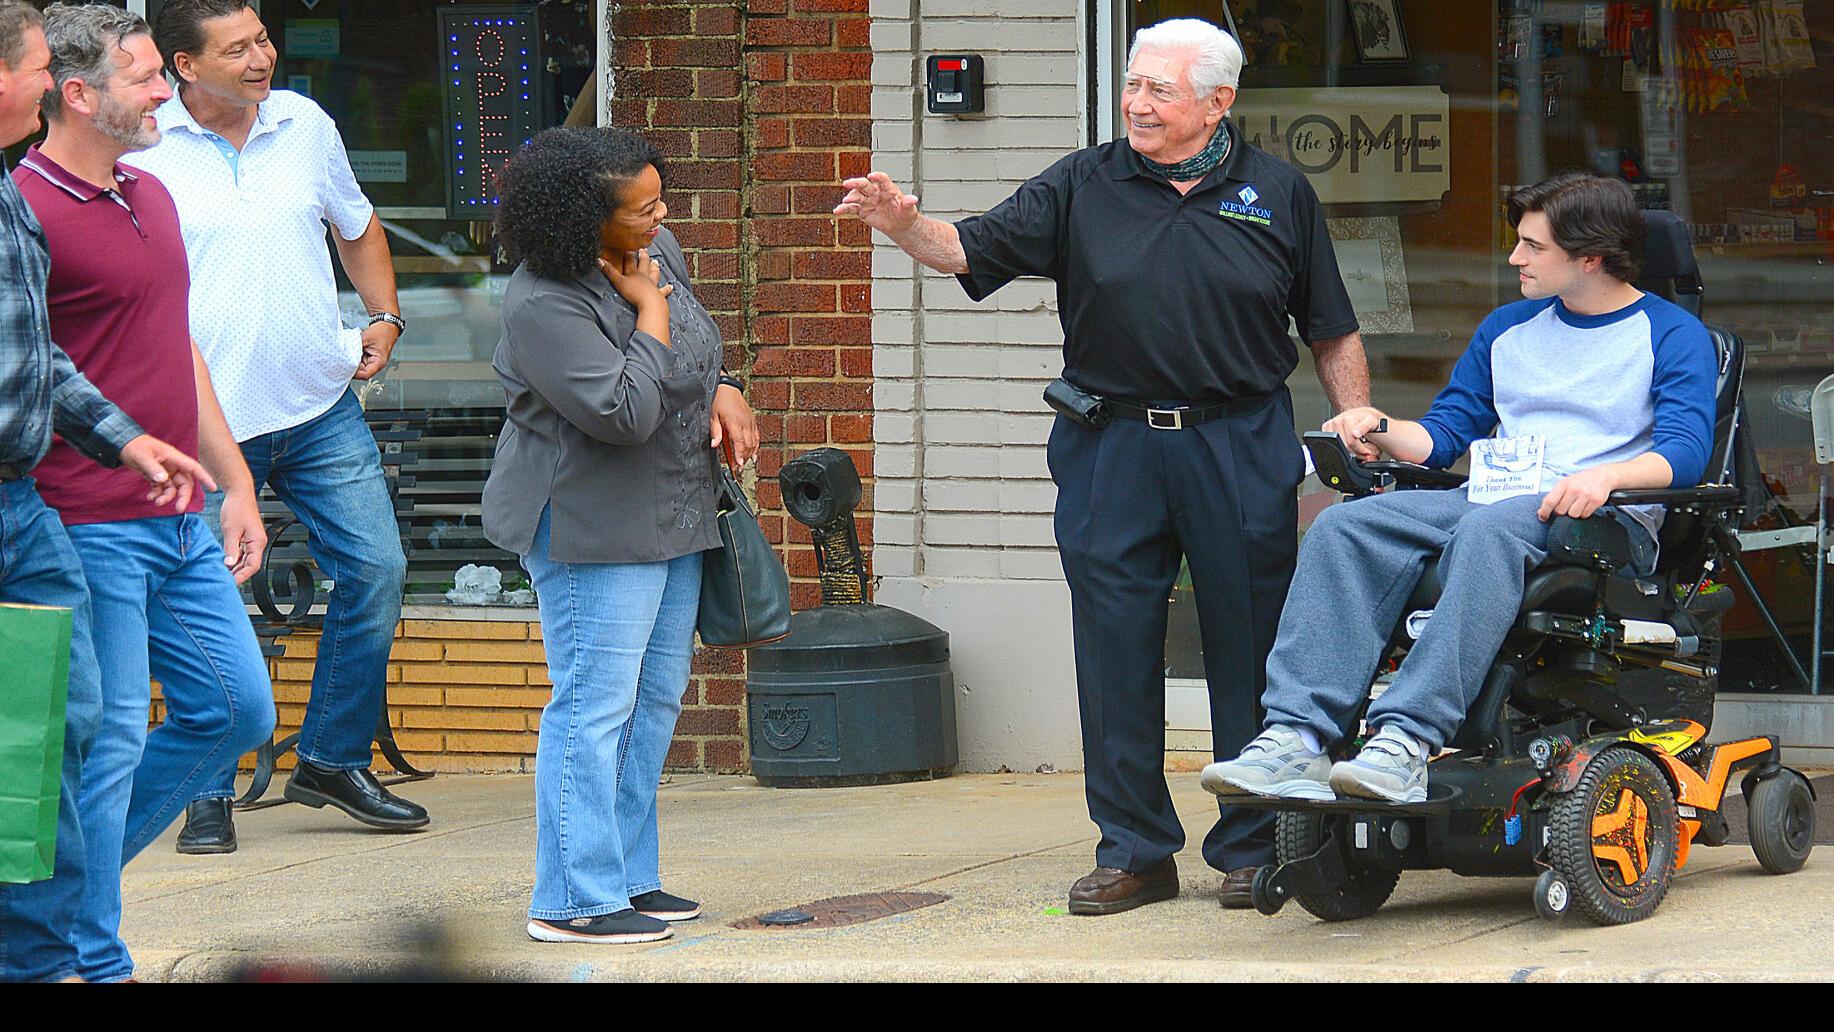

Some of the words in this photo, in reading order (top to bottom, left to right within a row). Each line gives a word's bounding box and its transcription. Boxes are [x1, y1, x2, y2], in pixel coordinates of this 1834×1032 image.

[476, 30, 510, 197] OPEN
[1295, 131, 1323, 152] the
[1328, 132, 1374, 157] story
[1383, 131, 1437, 156] begins
[1220, 201, 1272, 219] NEWTON
[1473, 484, 1485, 493] For
[1485, 484, 1502, 492] Your
[1486, 475, 1507, 483] Thank
[761, 702, 809, 723] Smokers
